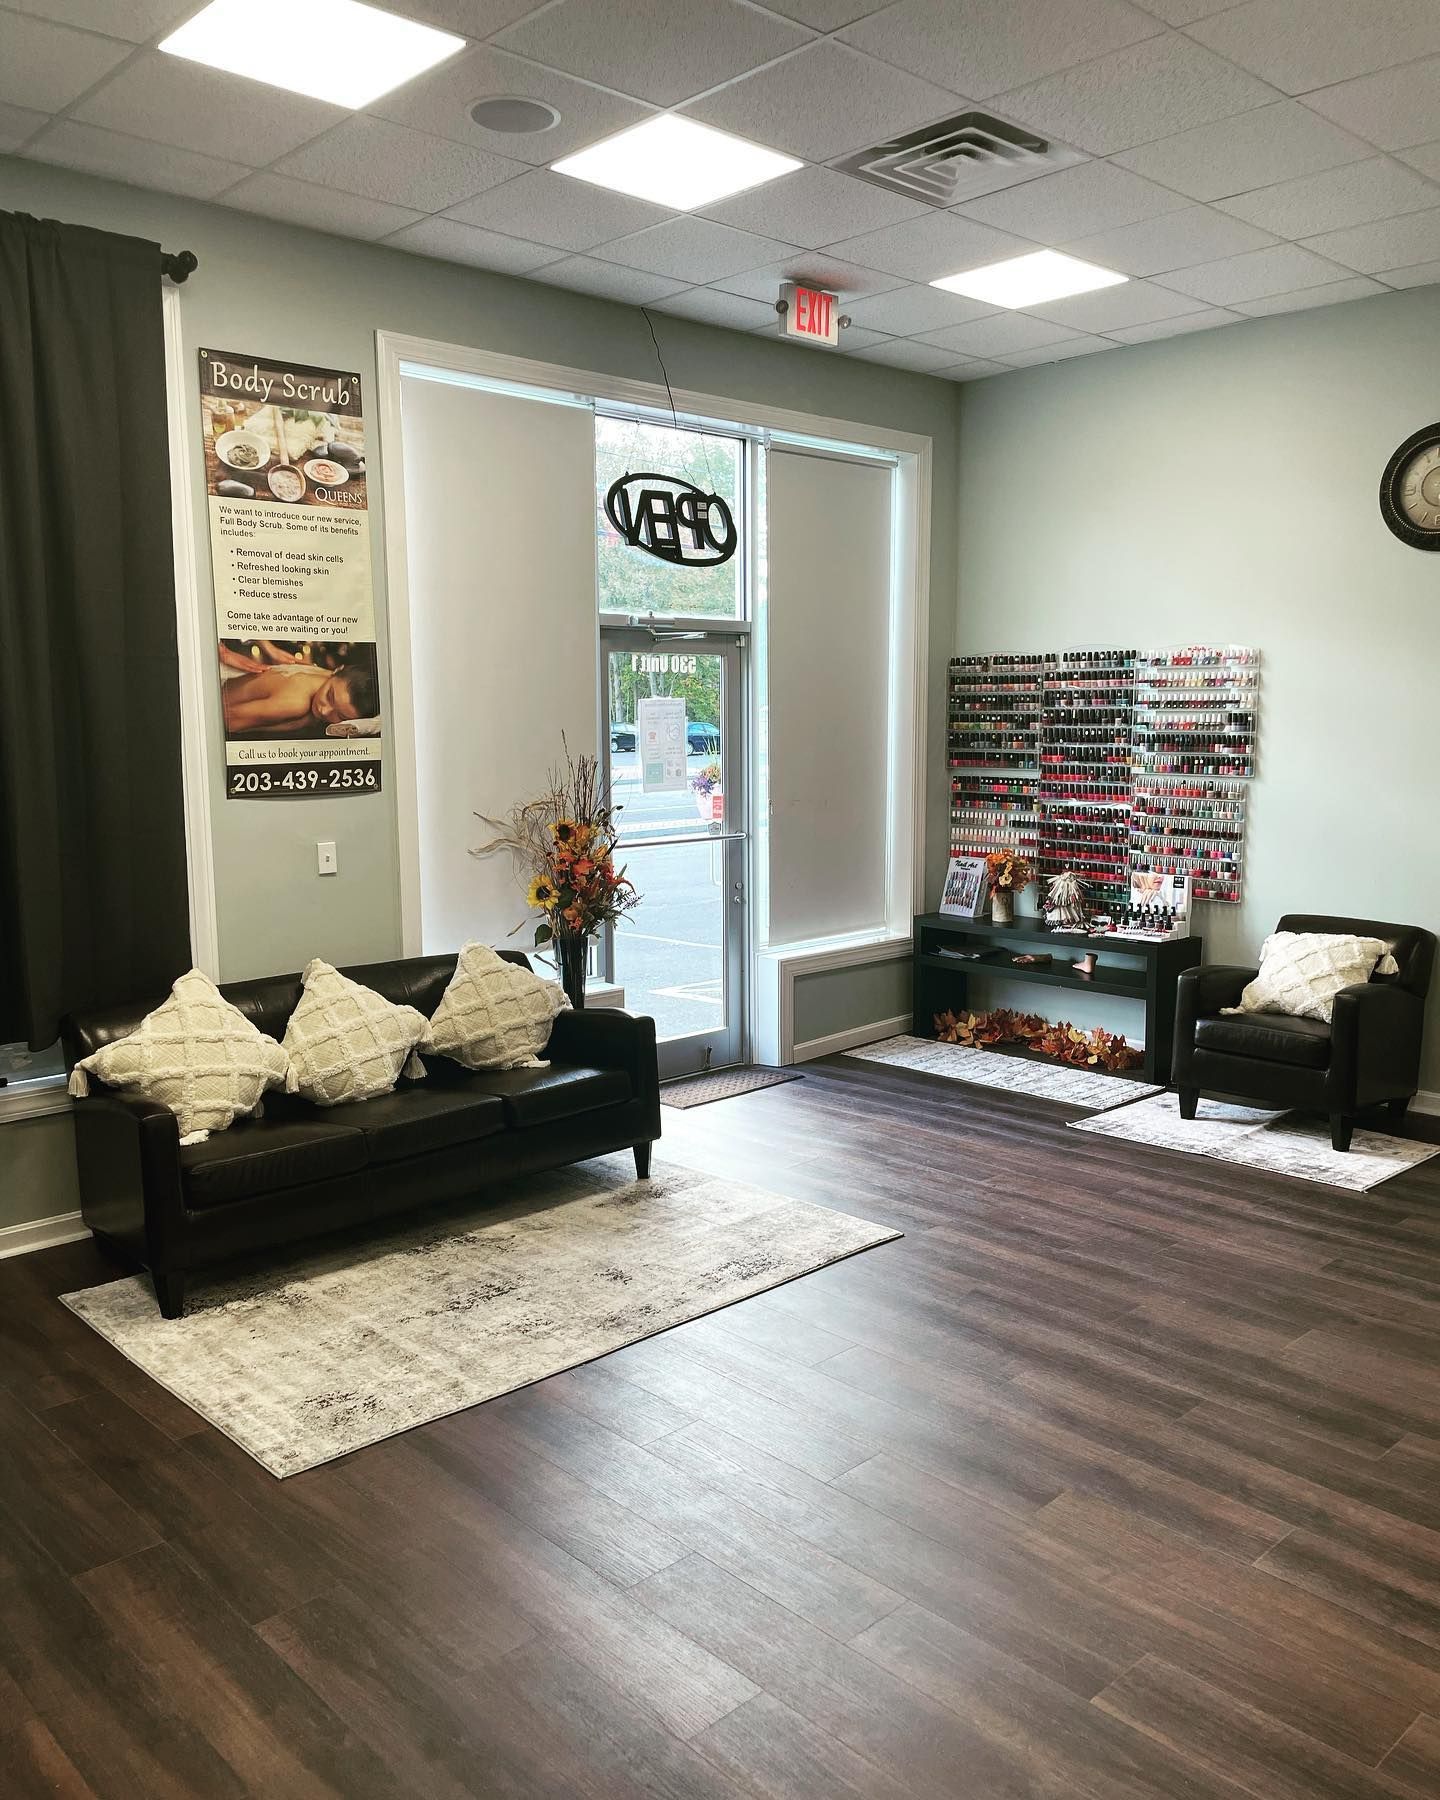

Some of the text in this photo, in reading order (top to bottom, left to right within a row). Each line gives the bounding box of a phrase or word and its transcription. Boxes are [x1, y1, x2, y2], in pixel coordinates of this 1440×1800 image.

[796, 287, 833, 337] EXIT
[210, 361, 350, 406] Body Scrub
[315, 487, 363, 505] QUEENS
[219, 505, 232, 514] We
[233, 508, 253, 516] want
[254, 509, 263, 517] to
[264, 510, 300, 521] introduce
[316, 515, 332, 523] new
[334, 516, 362, 527] service,
[220, 516, 235, 525] Full
[236, 518, 257, 528] Body
[286, 522, 308, 531] Some
[310, 524, 318, 532] of
[319, 525, 329, 533] its
[330, 526, 359, 536] benefits
[220, 528, 256, 538] includes:
[236, 547, 344, 563] Removal of dead skin cells
[237, 561, 330, 576] Refreshed looking skin
[238, 575, 304, 587] Clear blemishes
[239, 588, 298, 600] Reduce stress
[227, 610, 252, 620] Come
[253, 612, 271, 621] take
[272, 613, 314, 623] advantage
[316, 614, 324, 623] of
[326, 615, 340, 623] our
[227, 622, 260, 632] service,
[290, 625, 319, 635] waiting
[320, 626, 330, 634] or
[331, 626, 348, 635] you!
[238, 748, 256, 760] Call
[257, 752, 267, 760] us
[268, 750, 277, 759] to
[278, 747, 298, 758] book
[299, 750, 318, 761] your
[233, 768, 376, 792] 203-439-2536
